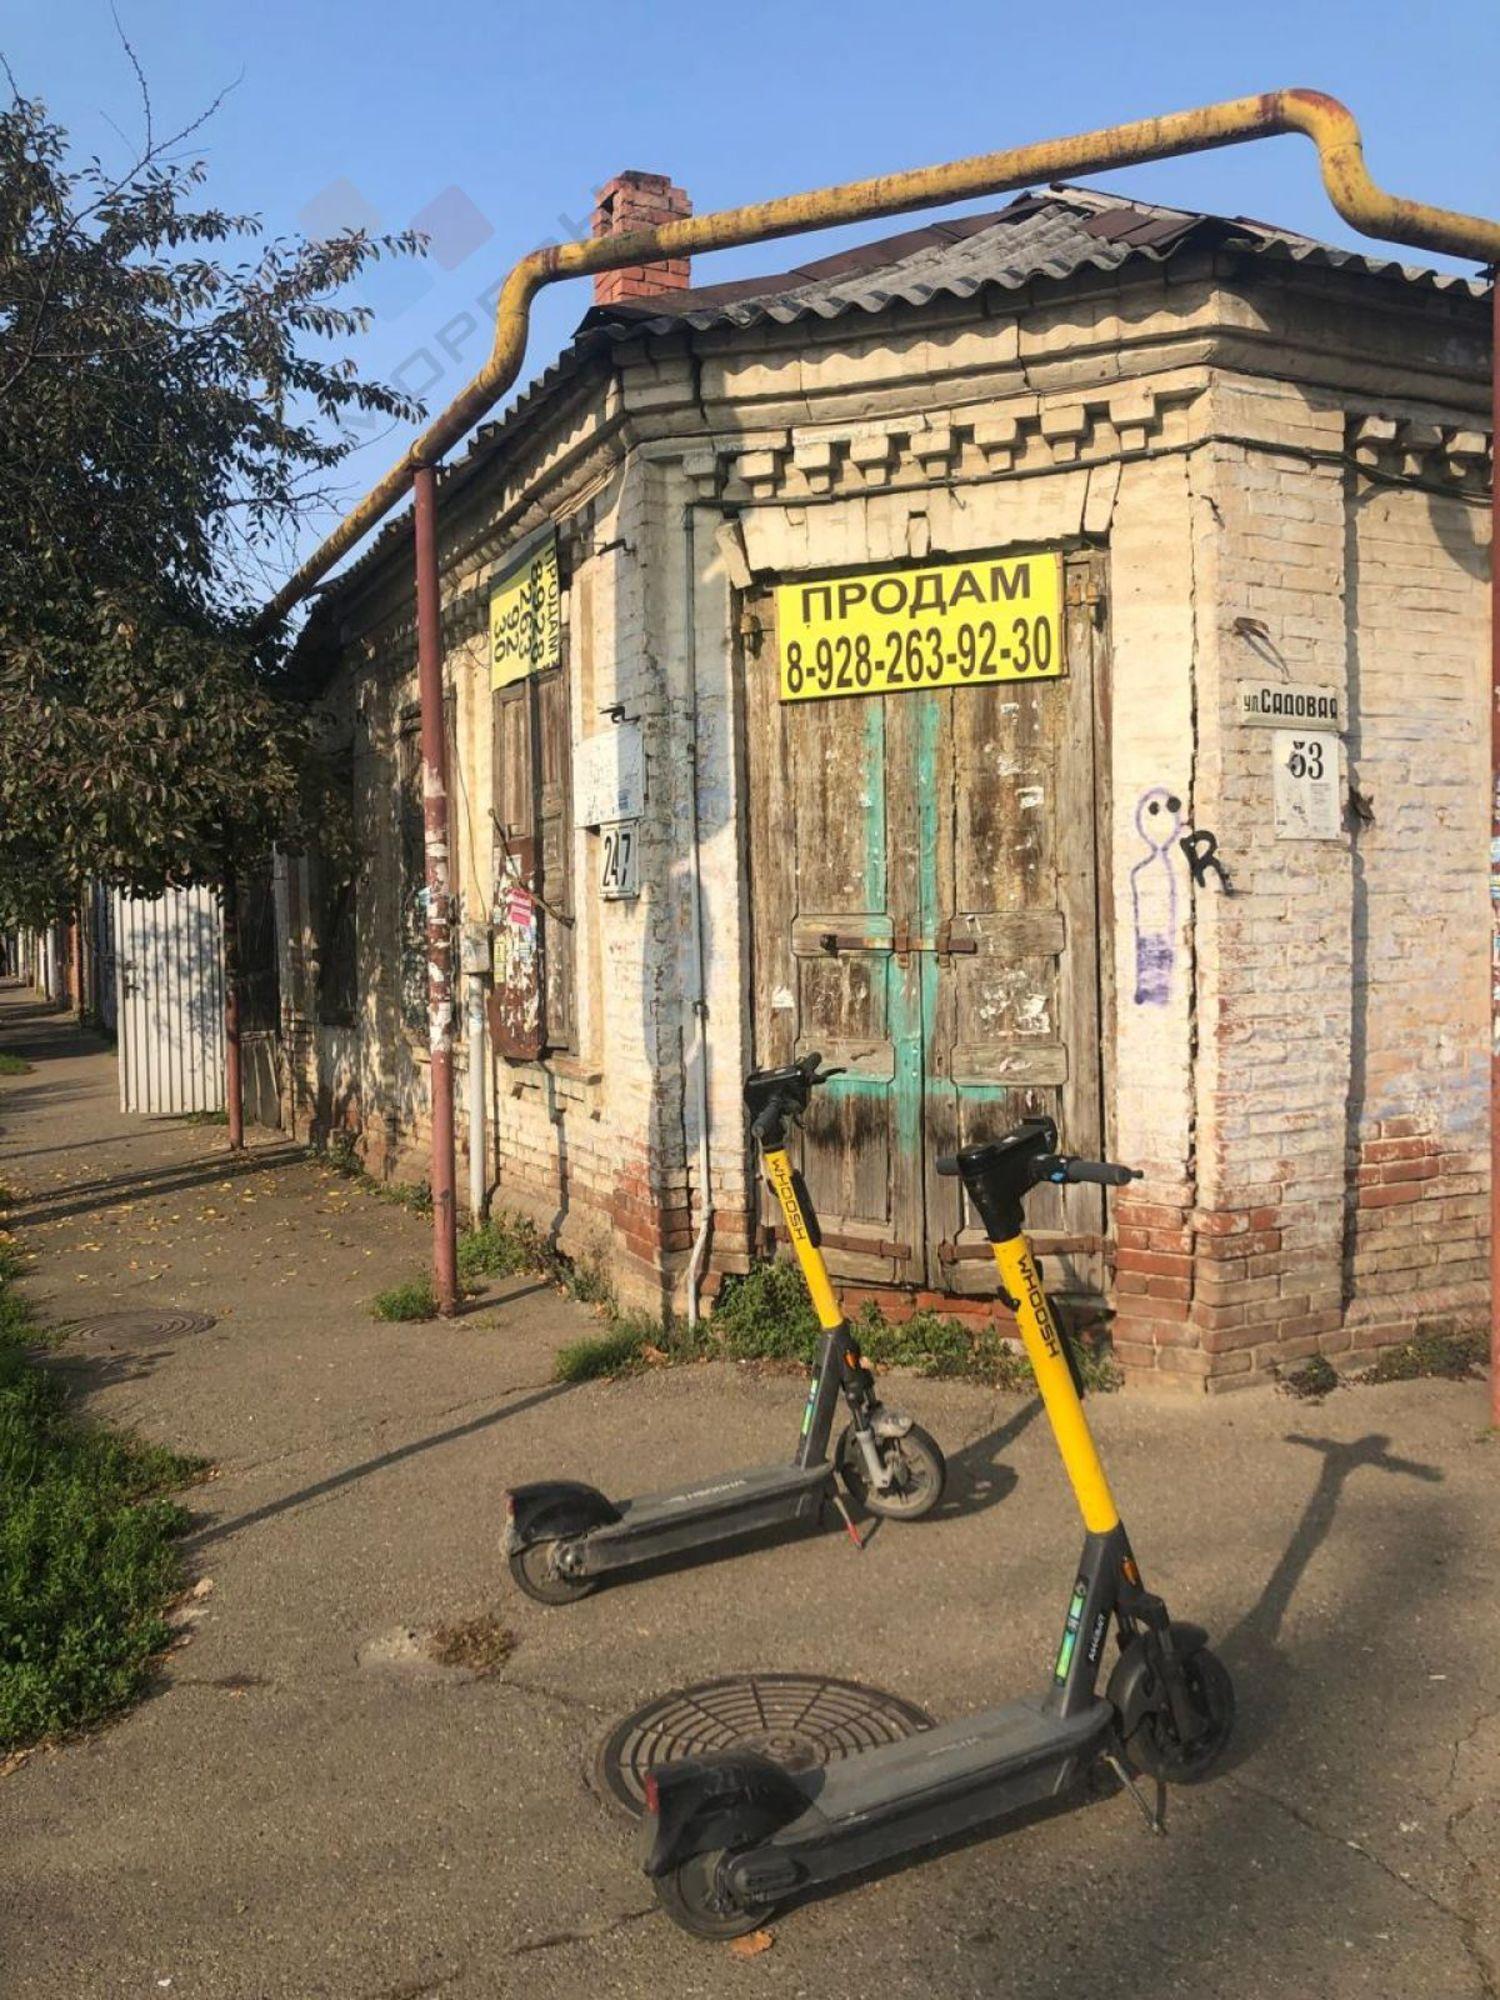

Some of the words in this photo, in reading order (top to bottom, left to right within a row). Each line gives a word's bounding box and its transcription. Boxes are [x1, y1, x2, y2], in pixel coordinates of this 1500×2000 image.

[519, 583, 533, 660] 263
[545, 547, 558, 655] ПРОДАМ
[801, 563, 1031, 624] ПРОДАМ
[494, 618, 507, 663] 30
[506, 605, 520, 658] 92
[786, 615, 1051, 694] 8-928-263-92-30
[1261, 688, 1338, 720] САДОВАЯ
[1290, 740, 1324, 780] 53
[771, 1159, 806, 1241] WHOOSH
[1017, 1253, 1060, 1357] WHOOSH
